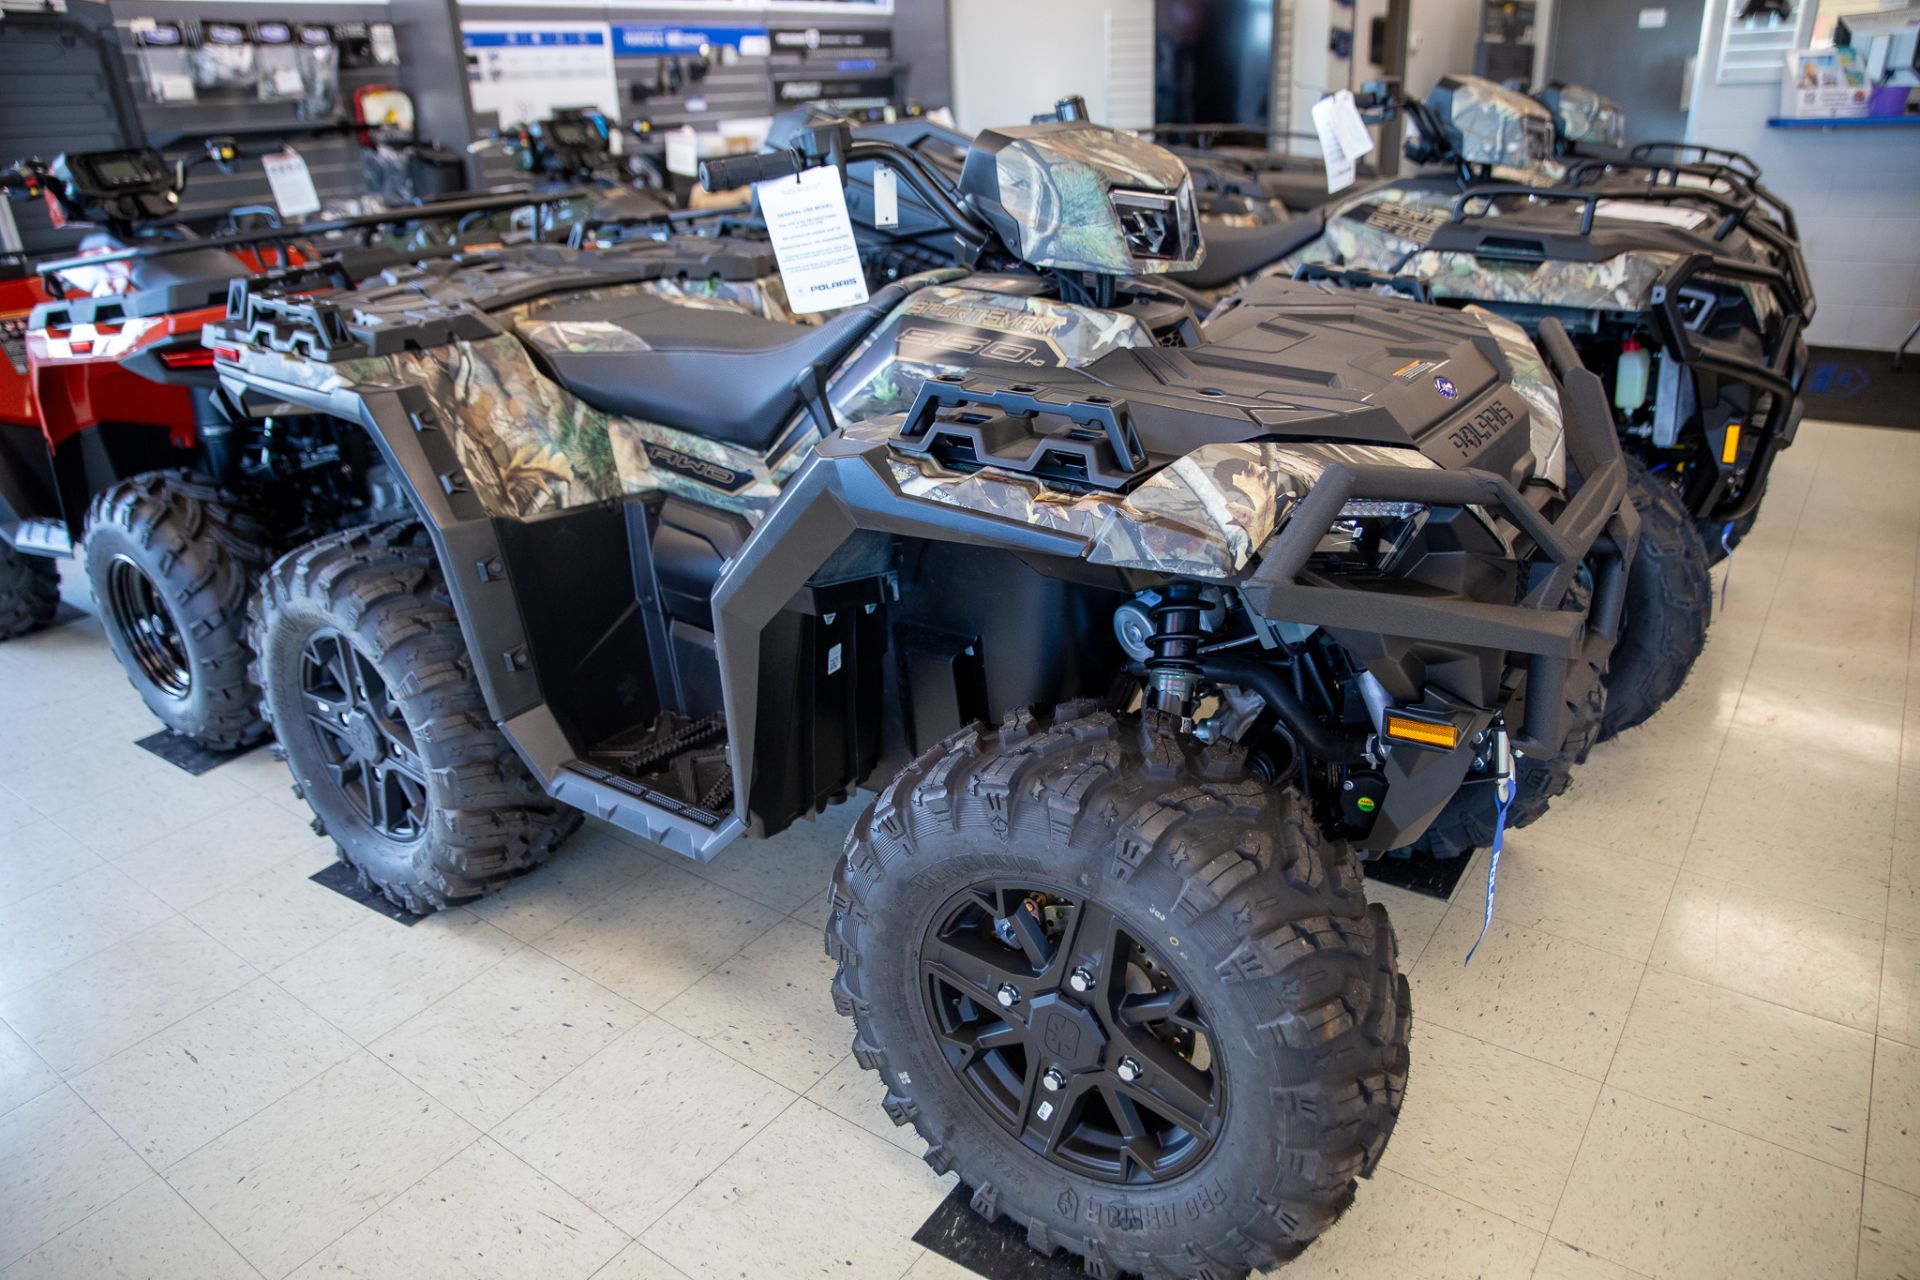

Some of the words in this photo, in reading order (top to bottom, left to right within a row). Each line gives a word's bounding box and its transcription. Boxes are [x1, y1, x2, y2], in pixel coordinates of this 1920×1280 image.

[810, 277, 857, 292] POLARIS
[907, 302, 1059, 335] SPORTSMAN
[1448, 400, 1514, 458] POLARIS
[650, 446, 736, 484] AWD
